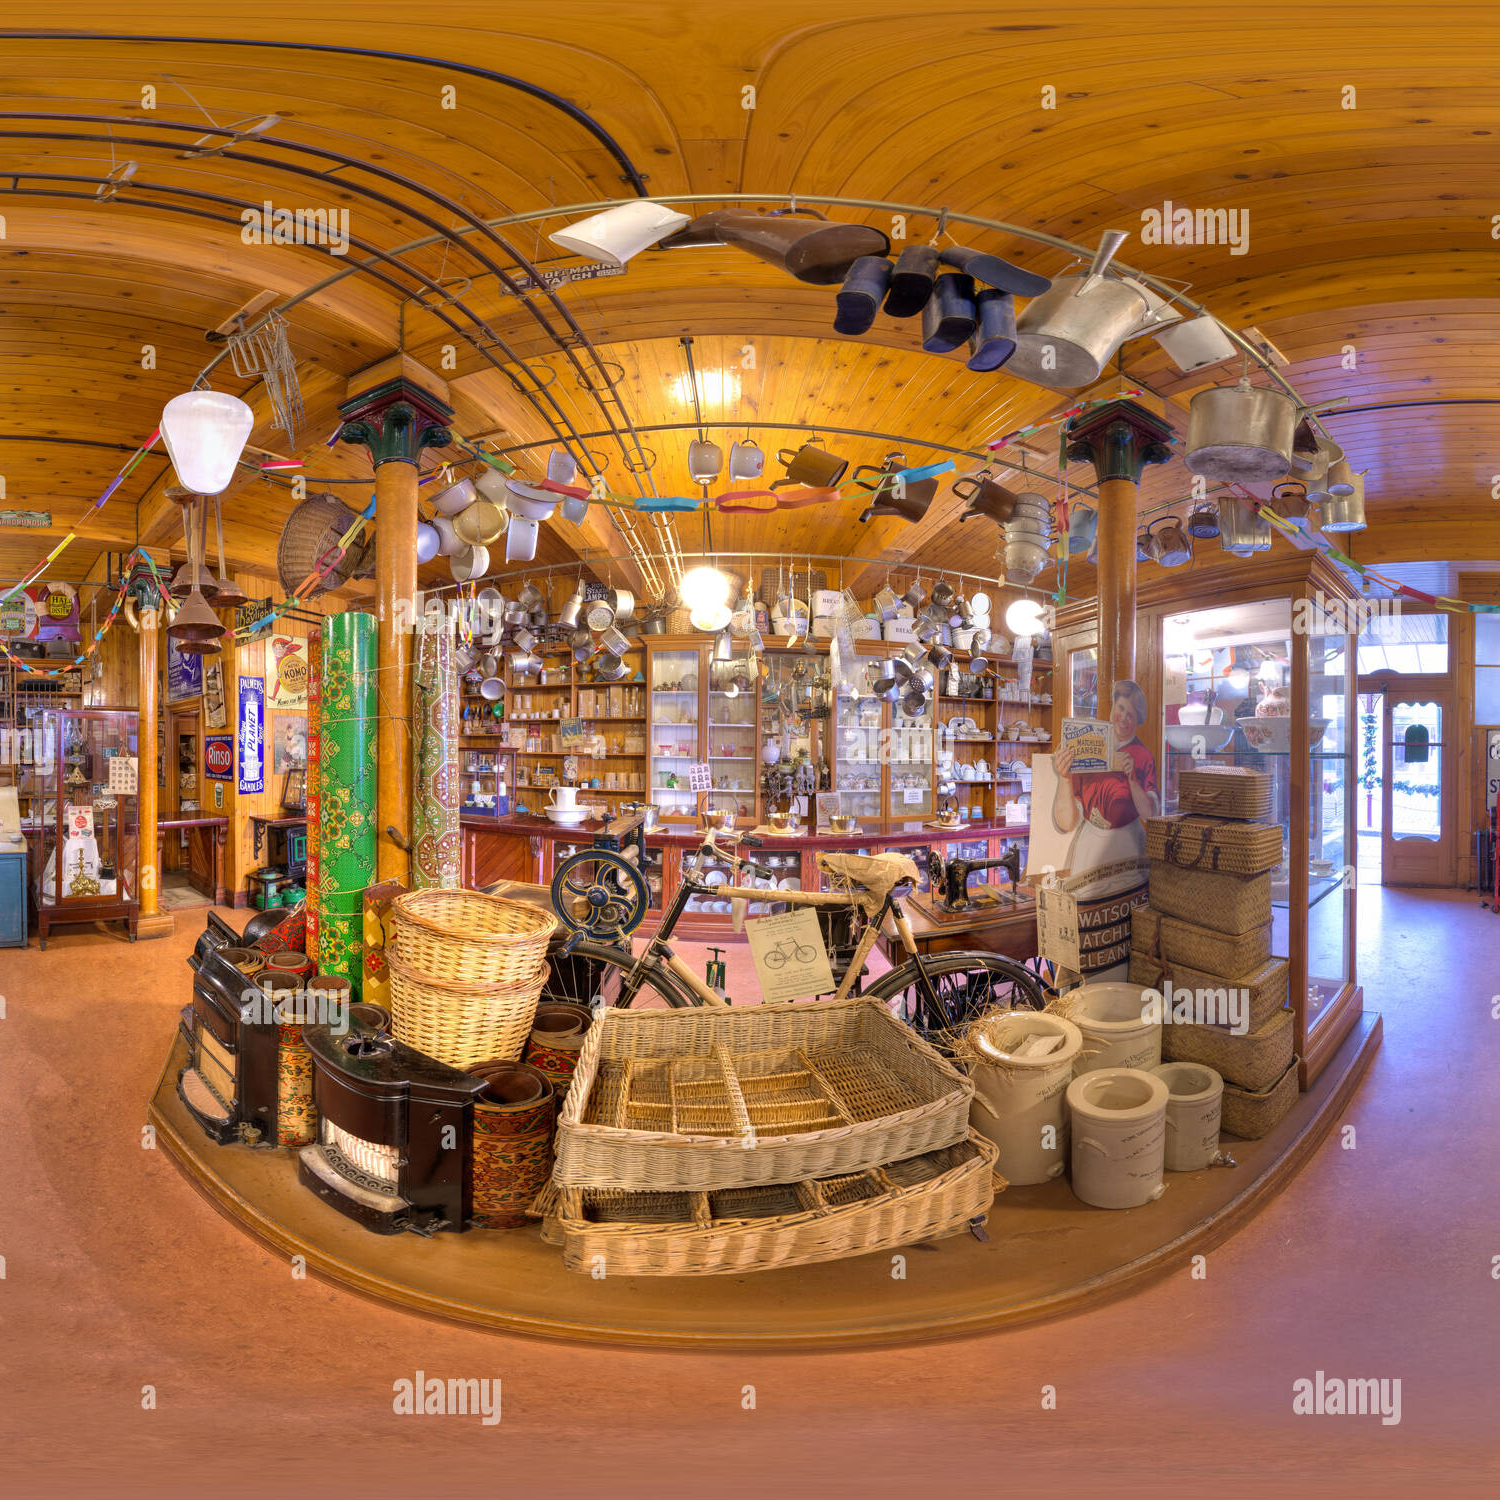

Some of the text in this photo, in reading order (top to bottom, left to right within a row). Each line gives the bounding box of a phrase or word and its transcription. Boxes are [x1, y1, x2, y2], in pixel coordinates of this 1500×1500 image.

[239, 608, 272, 627] Daylight
[245, 600, 267, 617] Royal
[283, 668, 307, 679] KOMO
[239, 678, 264, 694] PALMER'S
[246, 707, 256, 752] PLANET
[208, 746, 230, 765] Rinso
[239, 779, 264, 792] CANDLES
[1078, 893, 1149, 927] WATSON'S
